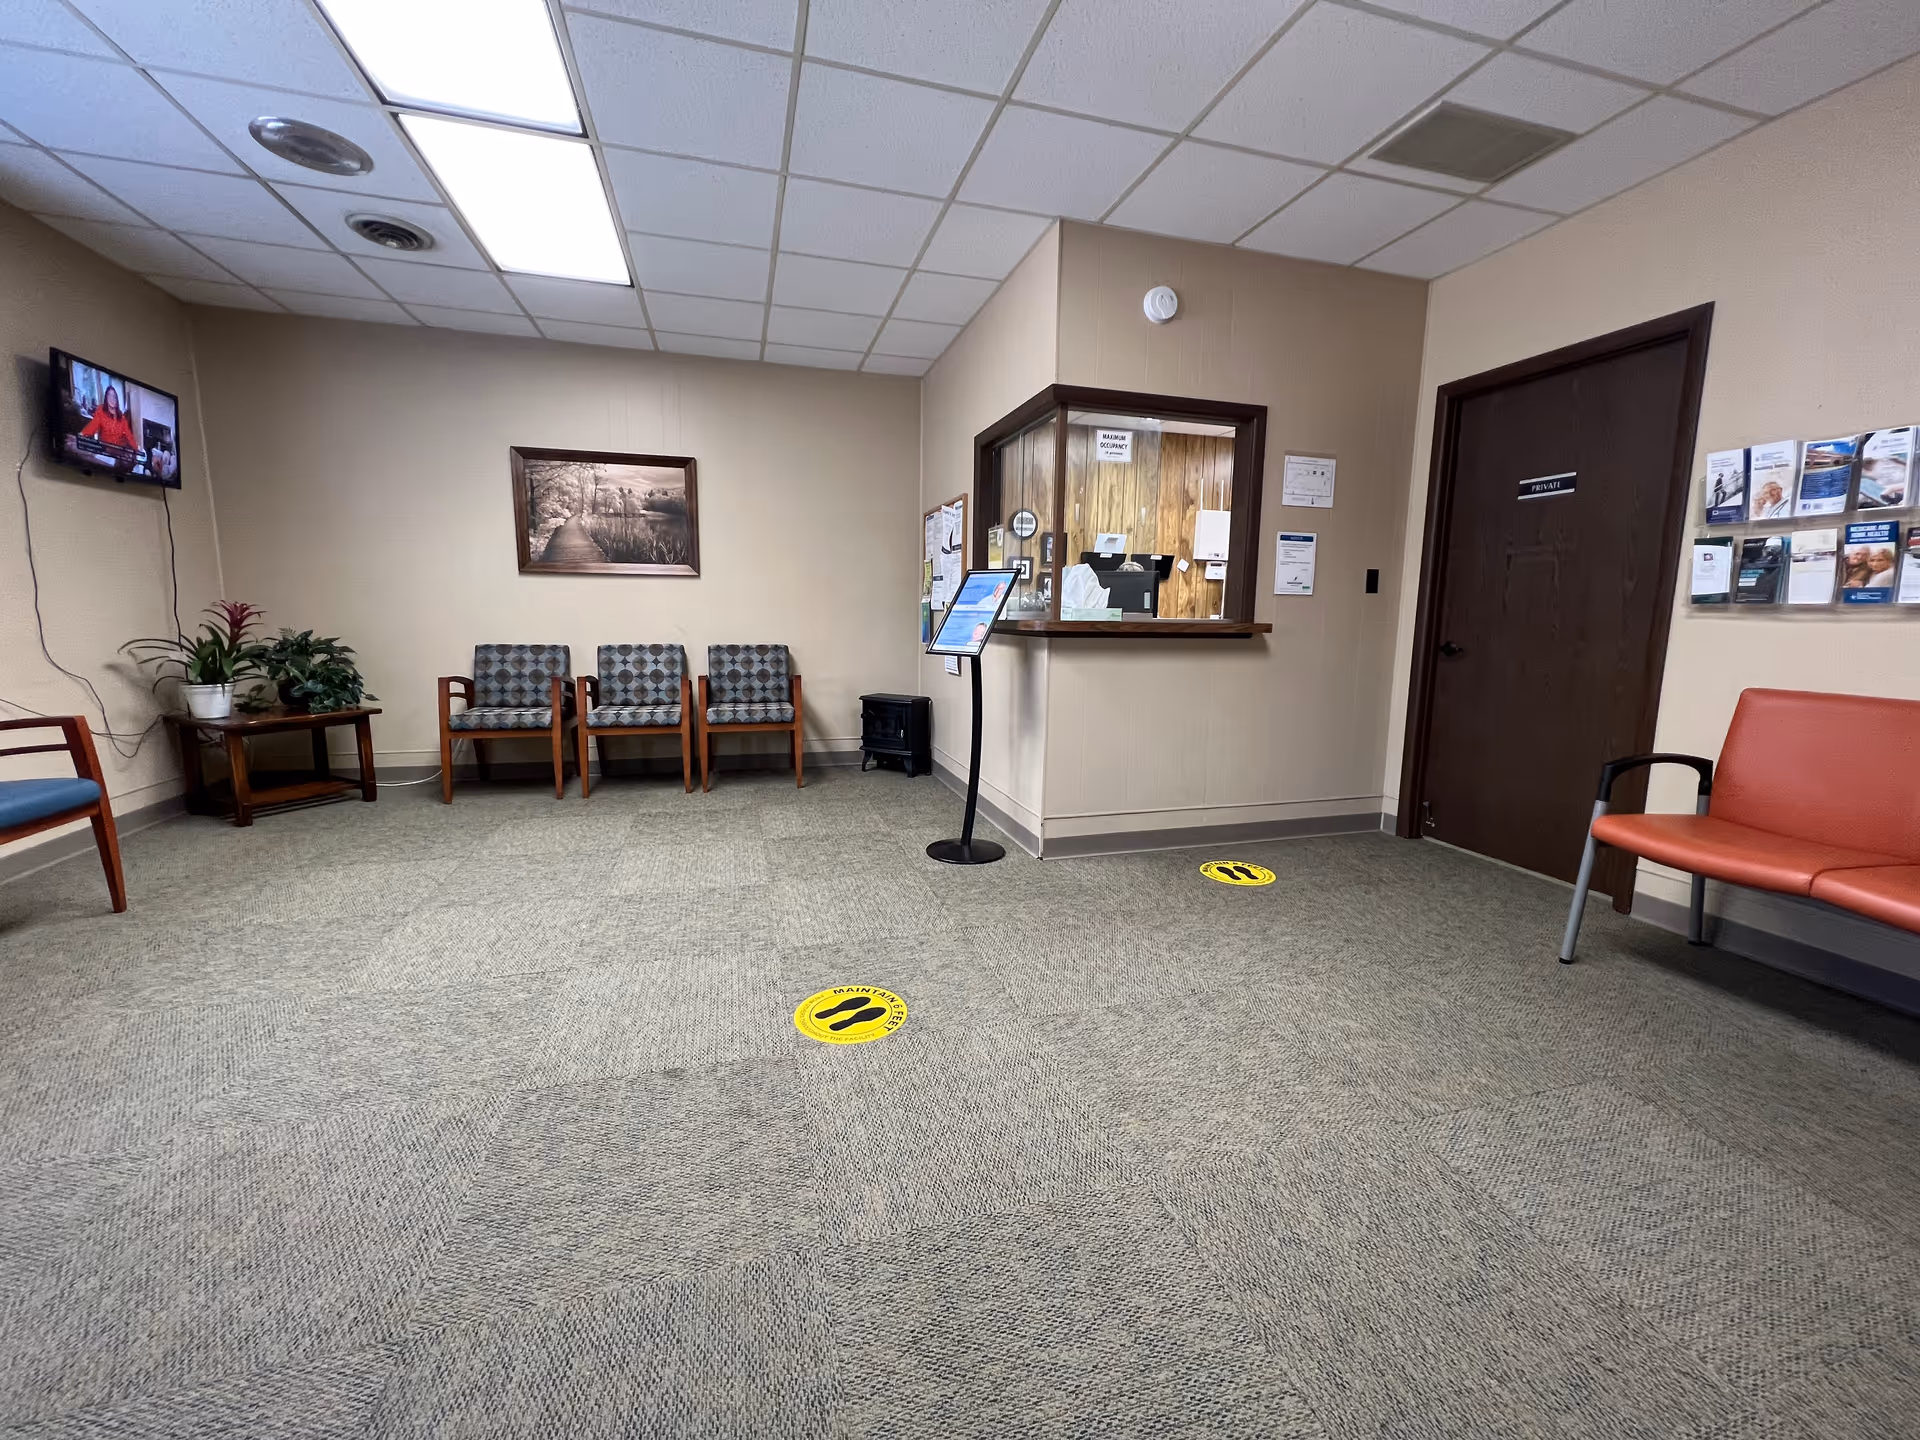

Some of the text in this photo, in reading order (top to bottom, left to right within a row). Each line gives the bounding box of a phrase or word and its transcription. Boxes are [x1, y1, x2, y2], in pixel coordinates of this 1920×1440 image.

[1102, 433, 1127, 441] MAXIMUM
[1099, 441, 1128, 450] OCCUPANCY
[1531, 480, 1561, 492] PRIVATE
[833, 987, 897, 1003] MAINTAIN
[884, 1011, 904, 1032] FEET
[844, 1033, 876, 1042] FACILITY
